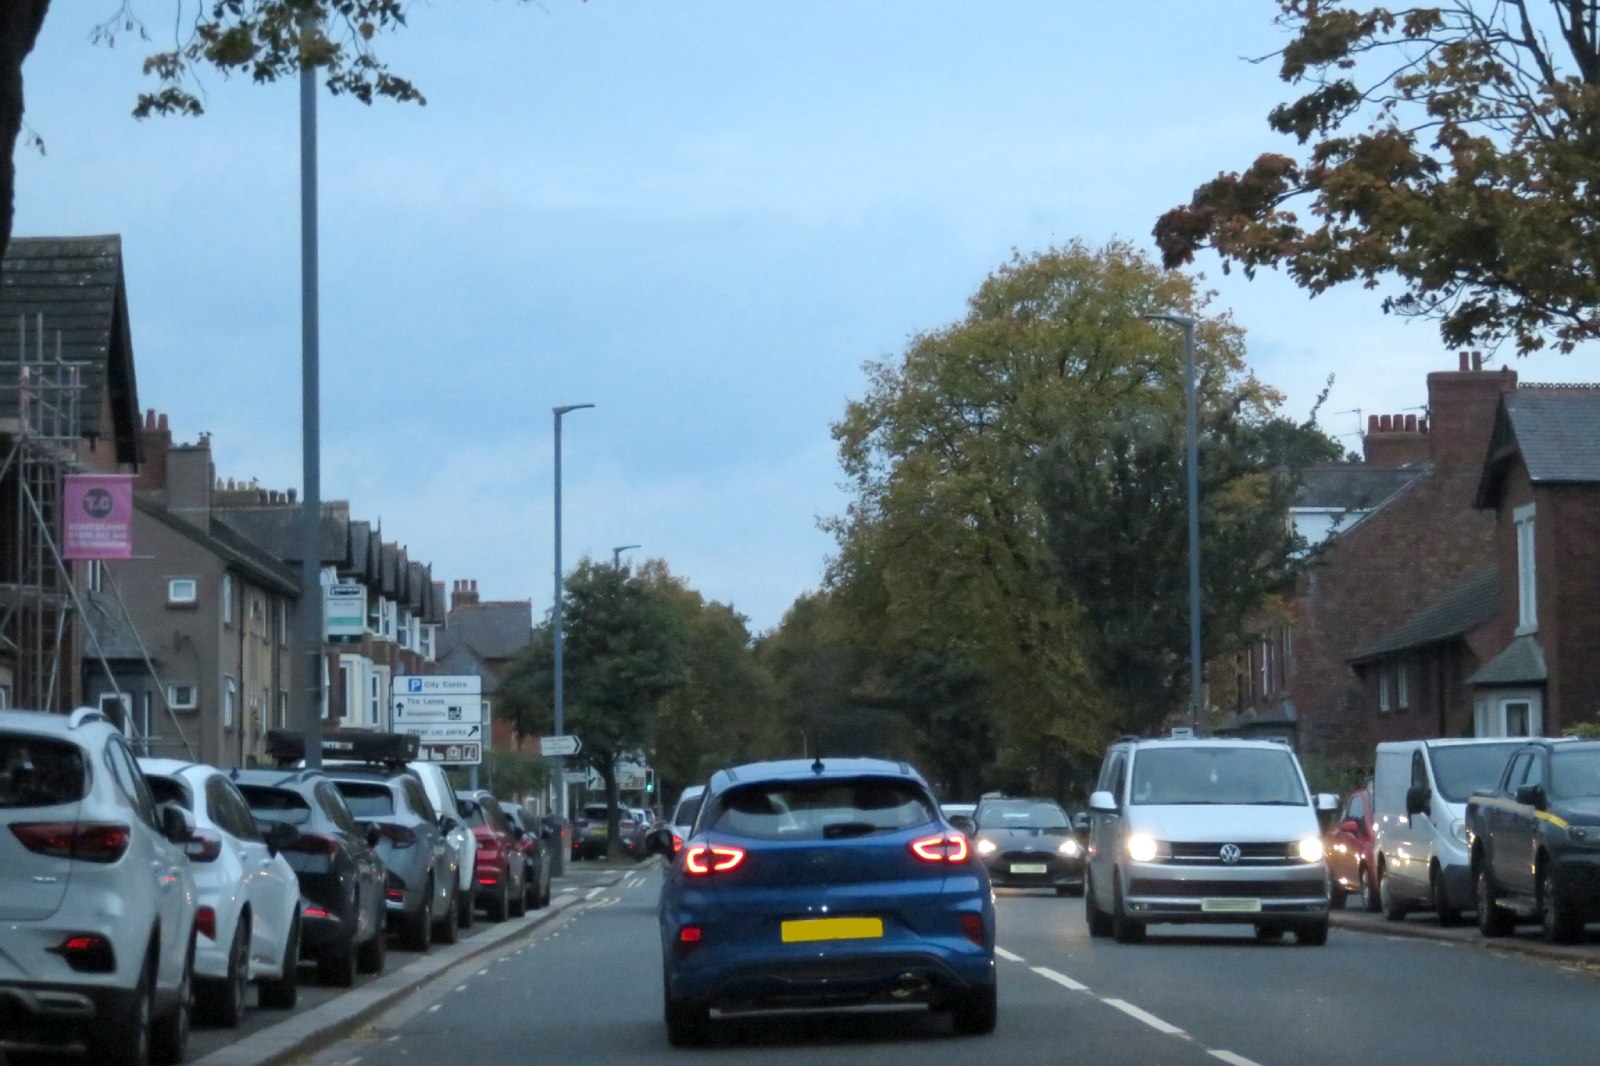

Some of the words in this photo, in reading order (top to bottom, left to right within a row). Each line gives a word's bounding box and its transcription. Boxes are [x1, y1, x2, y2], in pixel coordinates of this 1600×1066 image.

[424, 681, 440, 689] City
[442, 681, 468, 689] Centre
[446, 728, 468, 737] parks
